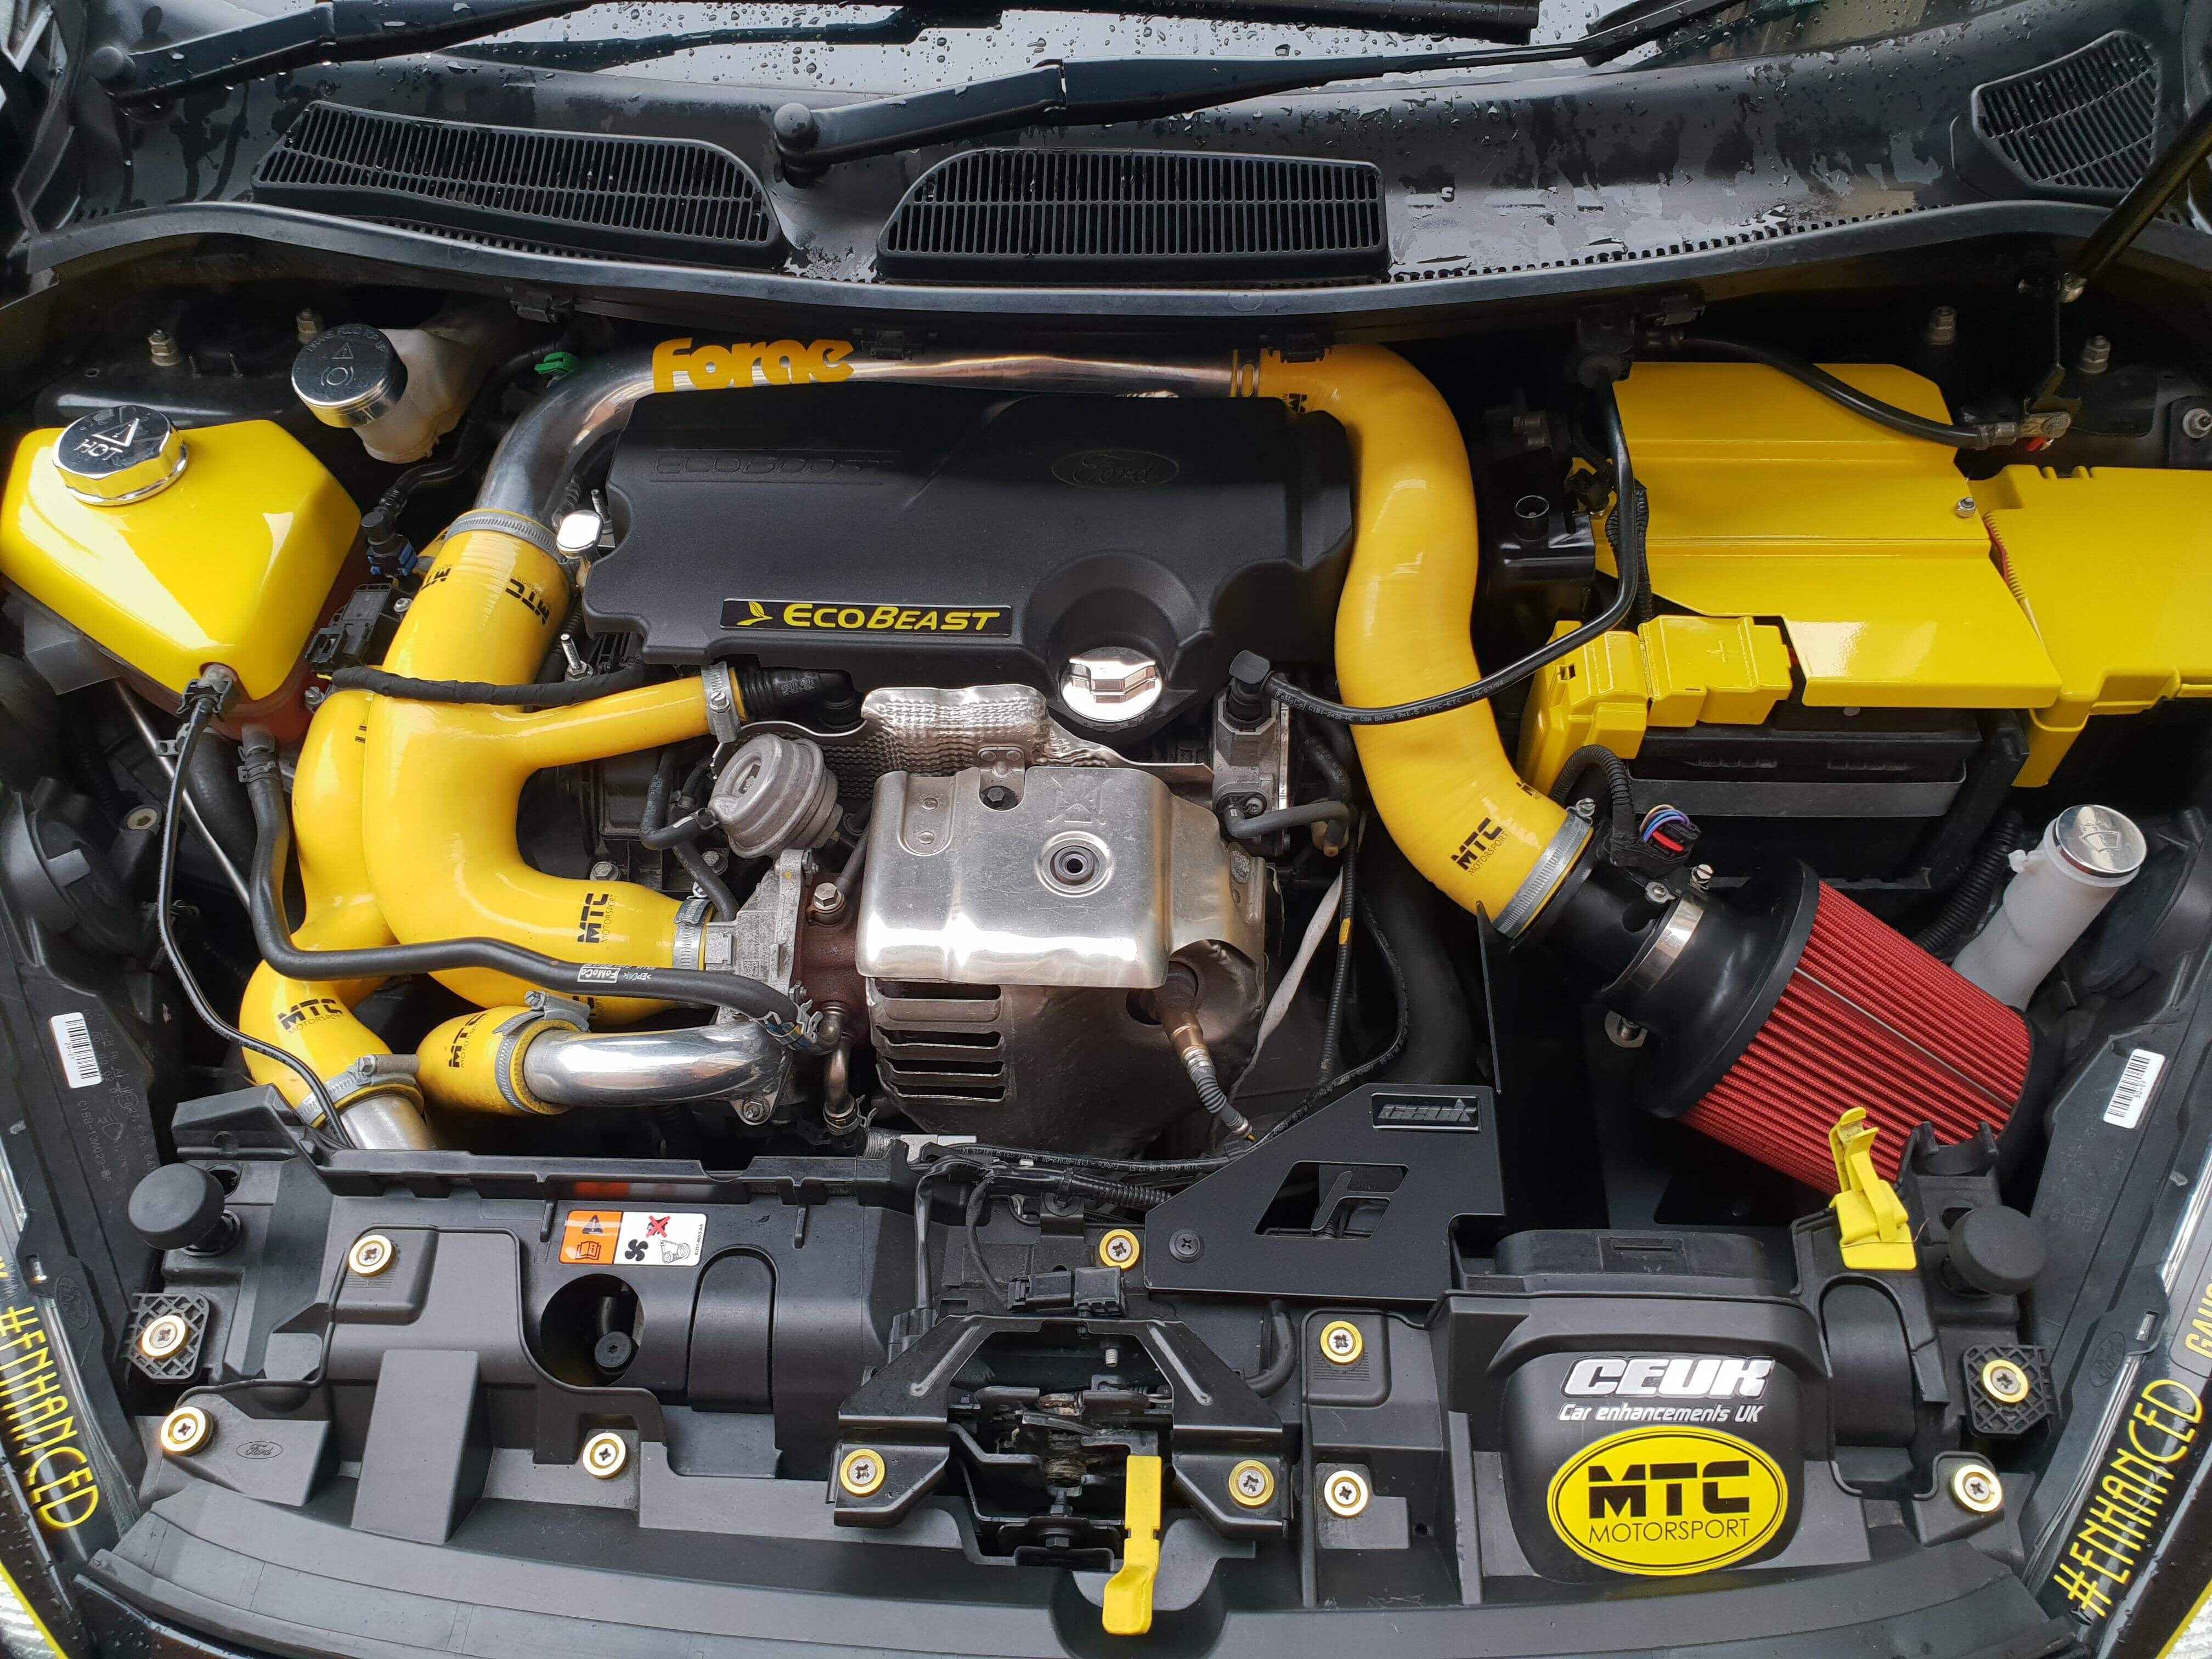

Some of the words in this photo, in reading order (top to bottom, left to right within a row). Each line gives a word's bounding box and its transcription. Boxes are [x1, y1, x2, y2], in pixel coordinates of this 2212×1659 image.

[74, 439, 123, 460] HOT
[505, 578, 549, 626] MTC
[1451, 817, 1503, 871] MTC
[1468, 830, 1510, 877] MOTORSPORT
[578, 893, 609, 943] MTC
[581, 968, 618, 979] FoMoCo
[277, 998, 343, 1030] MTC
[1562, 1358, 1775, 1398] CEUK
[0, 1306, 99, 1528] #ENHANCED
[1559, 1403, 1590, 1422] Car
[1595, 1403, 1731, 1423] enhancements
[1734, 1405, 1764, 1423] UK
[245, 1443, 274, 1456] Ford
[1588, 1460, 1750, 1519] MTC
[2054, 1379, 2203, 1617] #ENHANCED
[1589, 1518, 1750, 1544] MOTORSPORT
